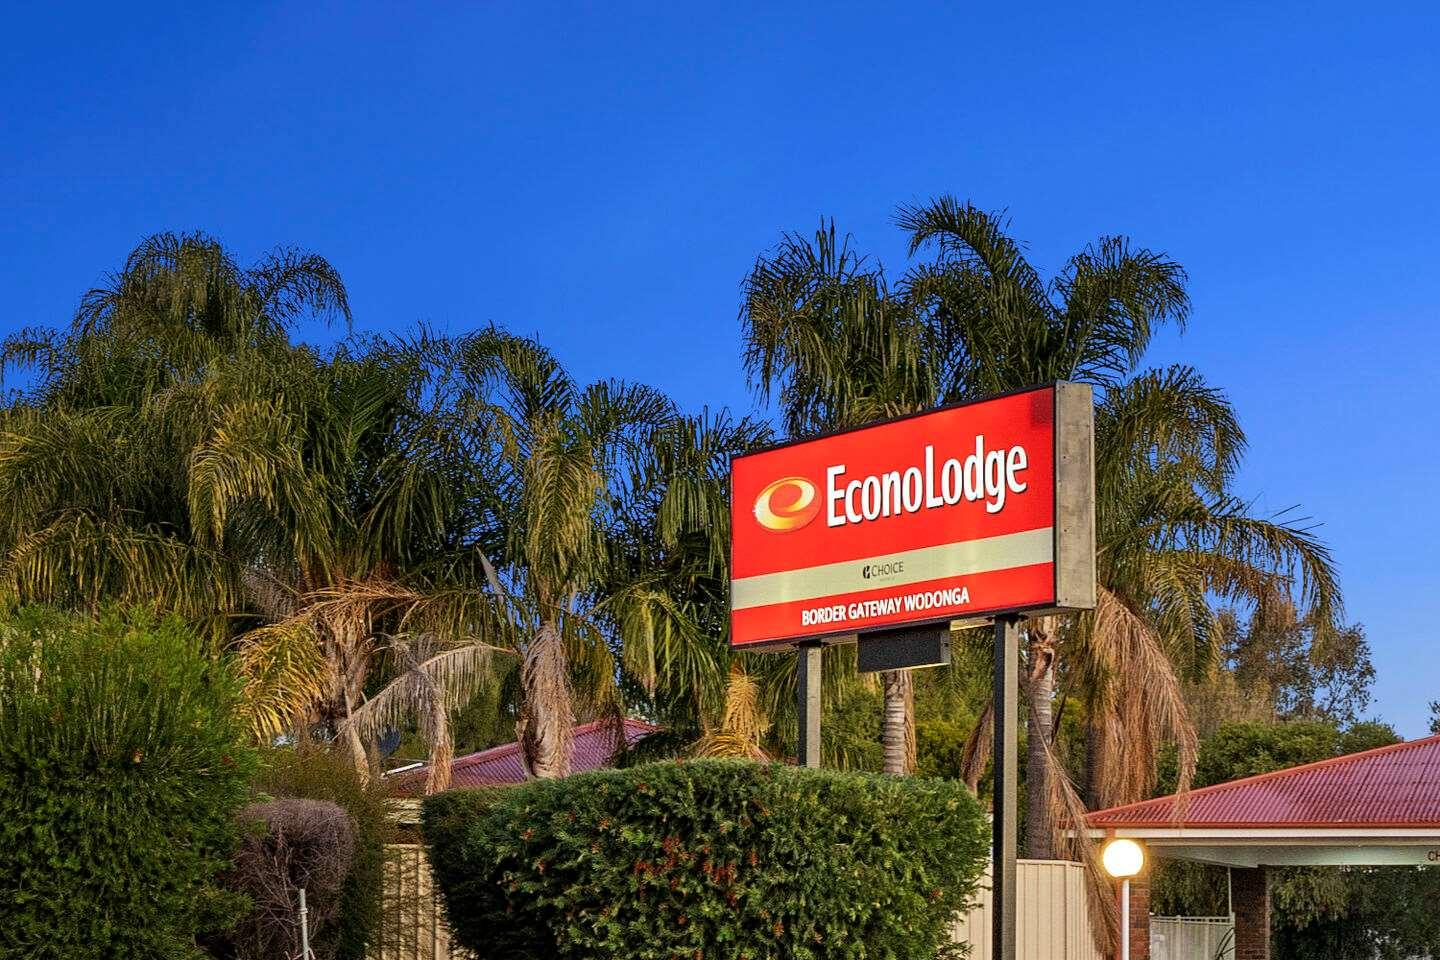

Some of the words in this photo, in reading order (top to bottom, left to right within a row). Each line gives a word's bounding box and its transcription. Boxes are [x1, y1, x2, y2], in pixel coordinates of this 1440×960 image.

[827, 435, 1028, 528] EconoLodge
[871, 561, 904, 577] CHOICE
[801, 605, 847, 626] BORDER
[848, 596, 903, 619] GATEWAY
[904, 586, 970, 611] WODONGA
